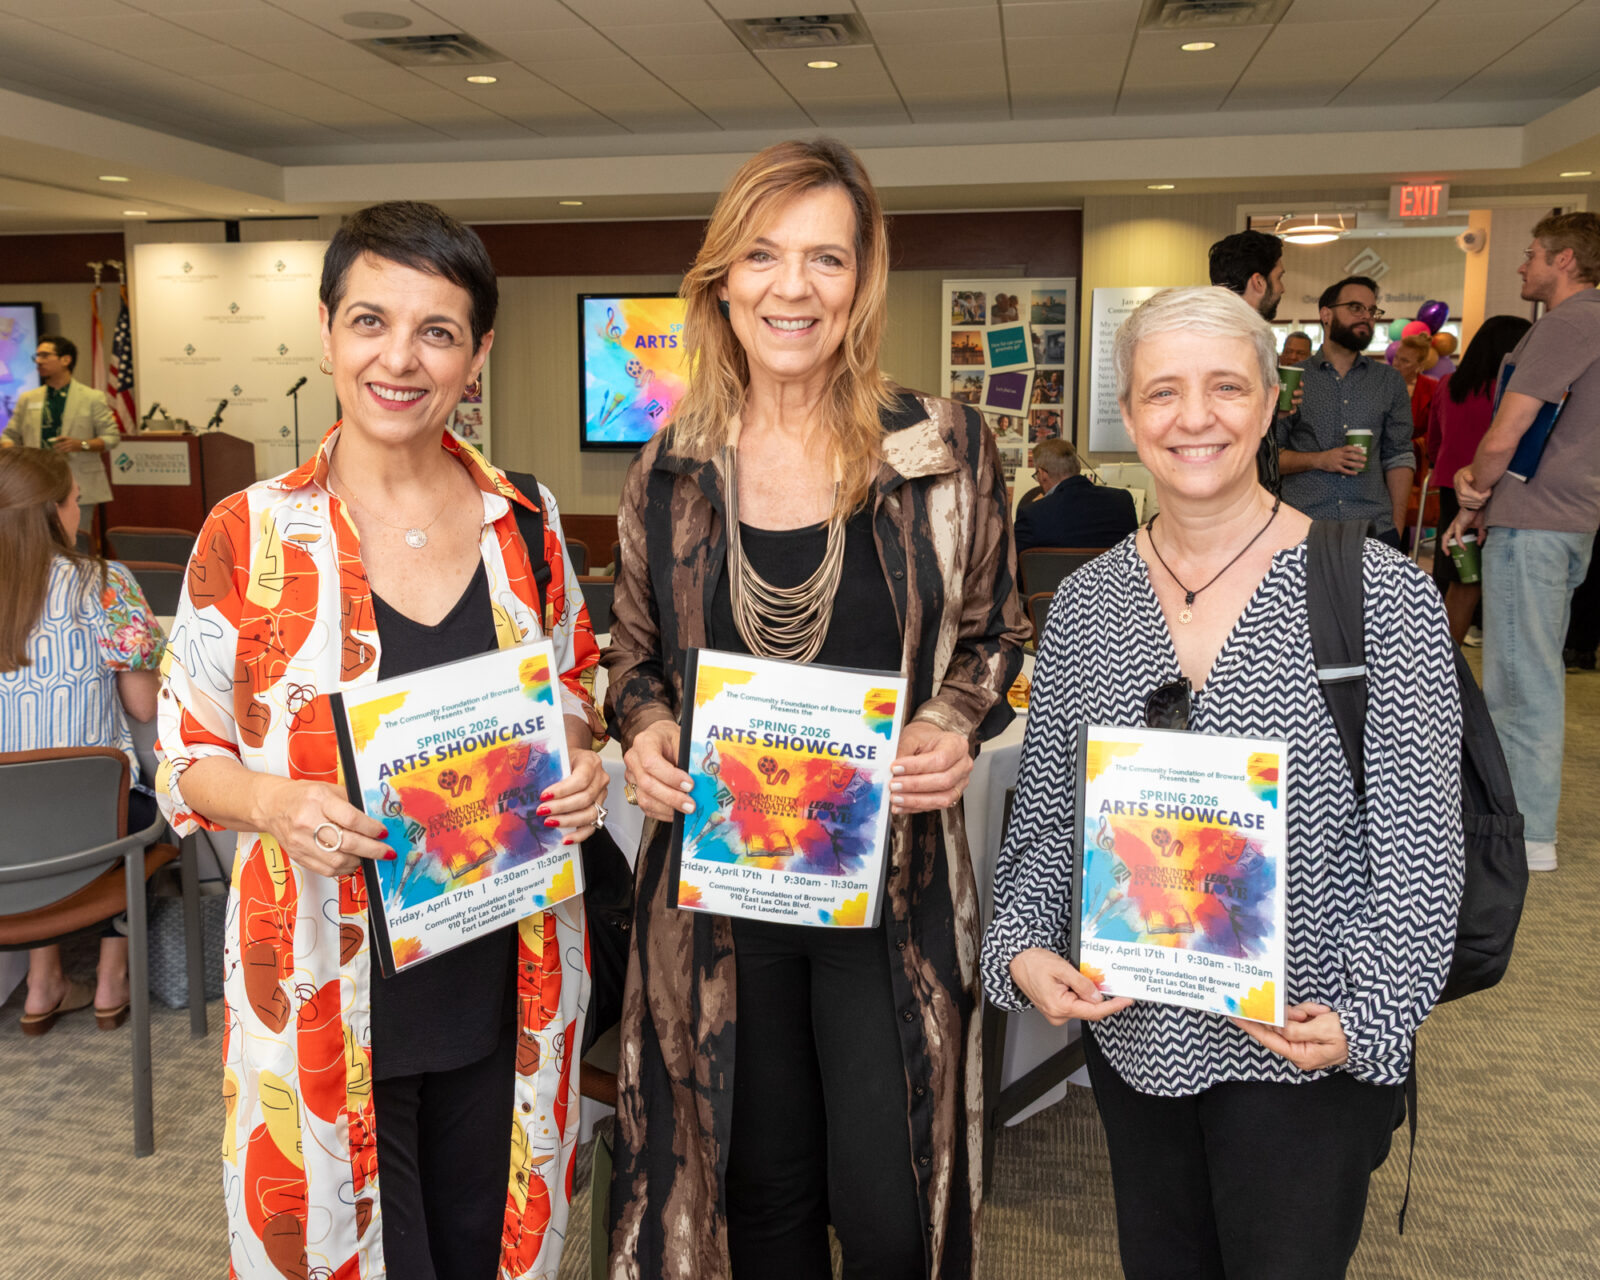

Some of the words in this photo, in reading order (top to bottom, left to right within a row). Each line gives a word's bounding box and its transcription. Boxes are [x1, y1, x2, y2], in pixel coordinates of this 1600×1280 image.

[1400, 185, 1442, 216] EXIT
[635, 335, 678, 349] ARTS
[385, 721, 398, 729] The
[400, 708, 440, 725] Community
[441, 697, 481, 712] Foundation
[482, 693, 490, 701] of
[490, 685, 521, 699] Broward
[433, 709, 463, 722] Presents
[464, 705, 477, 713] the
[726, 691, 739, 699] The
[740, 692, 779, 705] Community
[780, 699, 820, 711] Foundation
[821, 704, 829, 712] of
[829, 705, 862, 716] Broward
[770, 704, 800, 715] Presents
[416, 726, 467, 749] SPRING
[469, 716, 499, 734] 2026
[749, 718, 798, 735] SPRING
[800, 725, 832, 739] 2026
[378, 751, 431, 780] ARTS
[435, 715, 546, 762] SHOWCASE
[707, 724, 757, 746] ARTS
[762, 733, 877, 760] SHOWCASE
[1129, 765, 1167, 776] Community
[1168, 768, 1206, 778] Foundation
[1215, 772, 1246, 781] Broward
[1159, 774, 1189, 783] Presents
[1189, 776, 1201, 784] the
[498, 786, 521, 801] LEAD
[738, 791, 798, 805] COMMUNITY
[1139, 789, 1187, 805] SPRING
[1190, 794, 1219, 807] 2026
[427, 798, 488, 823] COMMUNITY
[737, 798, 799, 813] FOUNDATION
[752, 807, 798, 818] BROWARD
[808, 800, 835, 811] LEAD
[1099, 799, 1149, 817] ARTS
[1154, 803, 1265, 830] SHOWCASE
[429, 806, 490, 832] FOUNDATION
[445, 814, 491, 831] BROWARD
[715, 866, 739, 879] April
[741, 869, 763, 880] 17th
[783, 875, 822, 888] 9:30am
[831, 879, 869, 890] 11:30am
[1134, 864, 1195, 878] COMMUNITY
[1134, 871, 1195, 886] FOUNDATION
[1204, 872, 1230, 884] LEAD
[389, 910, 425, 929] Friday,
[427, 899, 452, 914] April
[453, 889, 475, 903] 17th
[493, 868, 529, 887] 9:30am
[537, 851, 571, 870] 11:30am
[708, 881, 751, 895] Community
[752, 888, 794, 900] Foundation
[794, 892, 803, 900] of
[803, 894, 836, 904] Broward
[424, 911, 467, 931] Community
[468, 893, 507, 914] Foundation
[508, 889, 516, 898] of
[516, 878, 546, 894] Broward
[729, 893, 743, 901] 910
[744, 894, 760, 903] East
[760, 896, 773, 905] Las
[774, 898, 791, 908] Olas
[792, 900, 812, 909] Blvd.
[741, 902, 757, 911] Fort
[758, 905, 799, 916] Lauderdale
[448, 920, 461, 931] 910
[462, 914, 478, 925] East
[479, 909, 490, 919] Las
[490, 902, 507, 915] Olas
[508, 895, 527, 908] Blvd.
[462, 924, 478, 935] Fort
[478, 907, 517, 929] Lauderdale
[1080, 941, 1114, 955] Friday,
[1116, 945, 1141, 959] April
[1144, 948, 1165, 959] 17th
[1187, 954, 1225, 969] 9:30am
[1234, 962, 1273, 979] 11:30am
[1111, 962, 1154, 976] Community
[1156, 968, 1198, 981] Foundation
[1199, 974, 1208, 982] of
[1208, 976, 1240, 989] Broward
[1133, 974, 1147, 983] 910
[1148, 976, 1165, 986] East
[1165, 978, 1178, 987] Las
[1179, 980, 1197, 990] Olas
[1198, 983, 1217, 994] Blvd.
[1146, 984, 1162, 994] Fort
[1163, 988, 1205, 1000] Lauderdale
